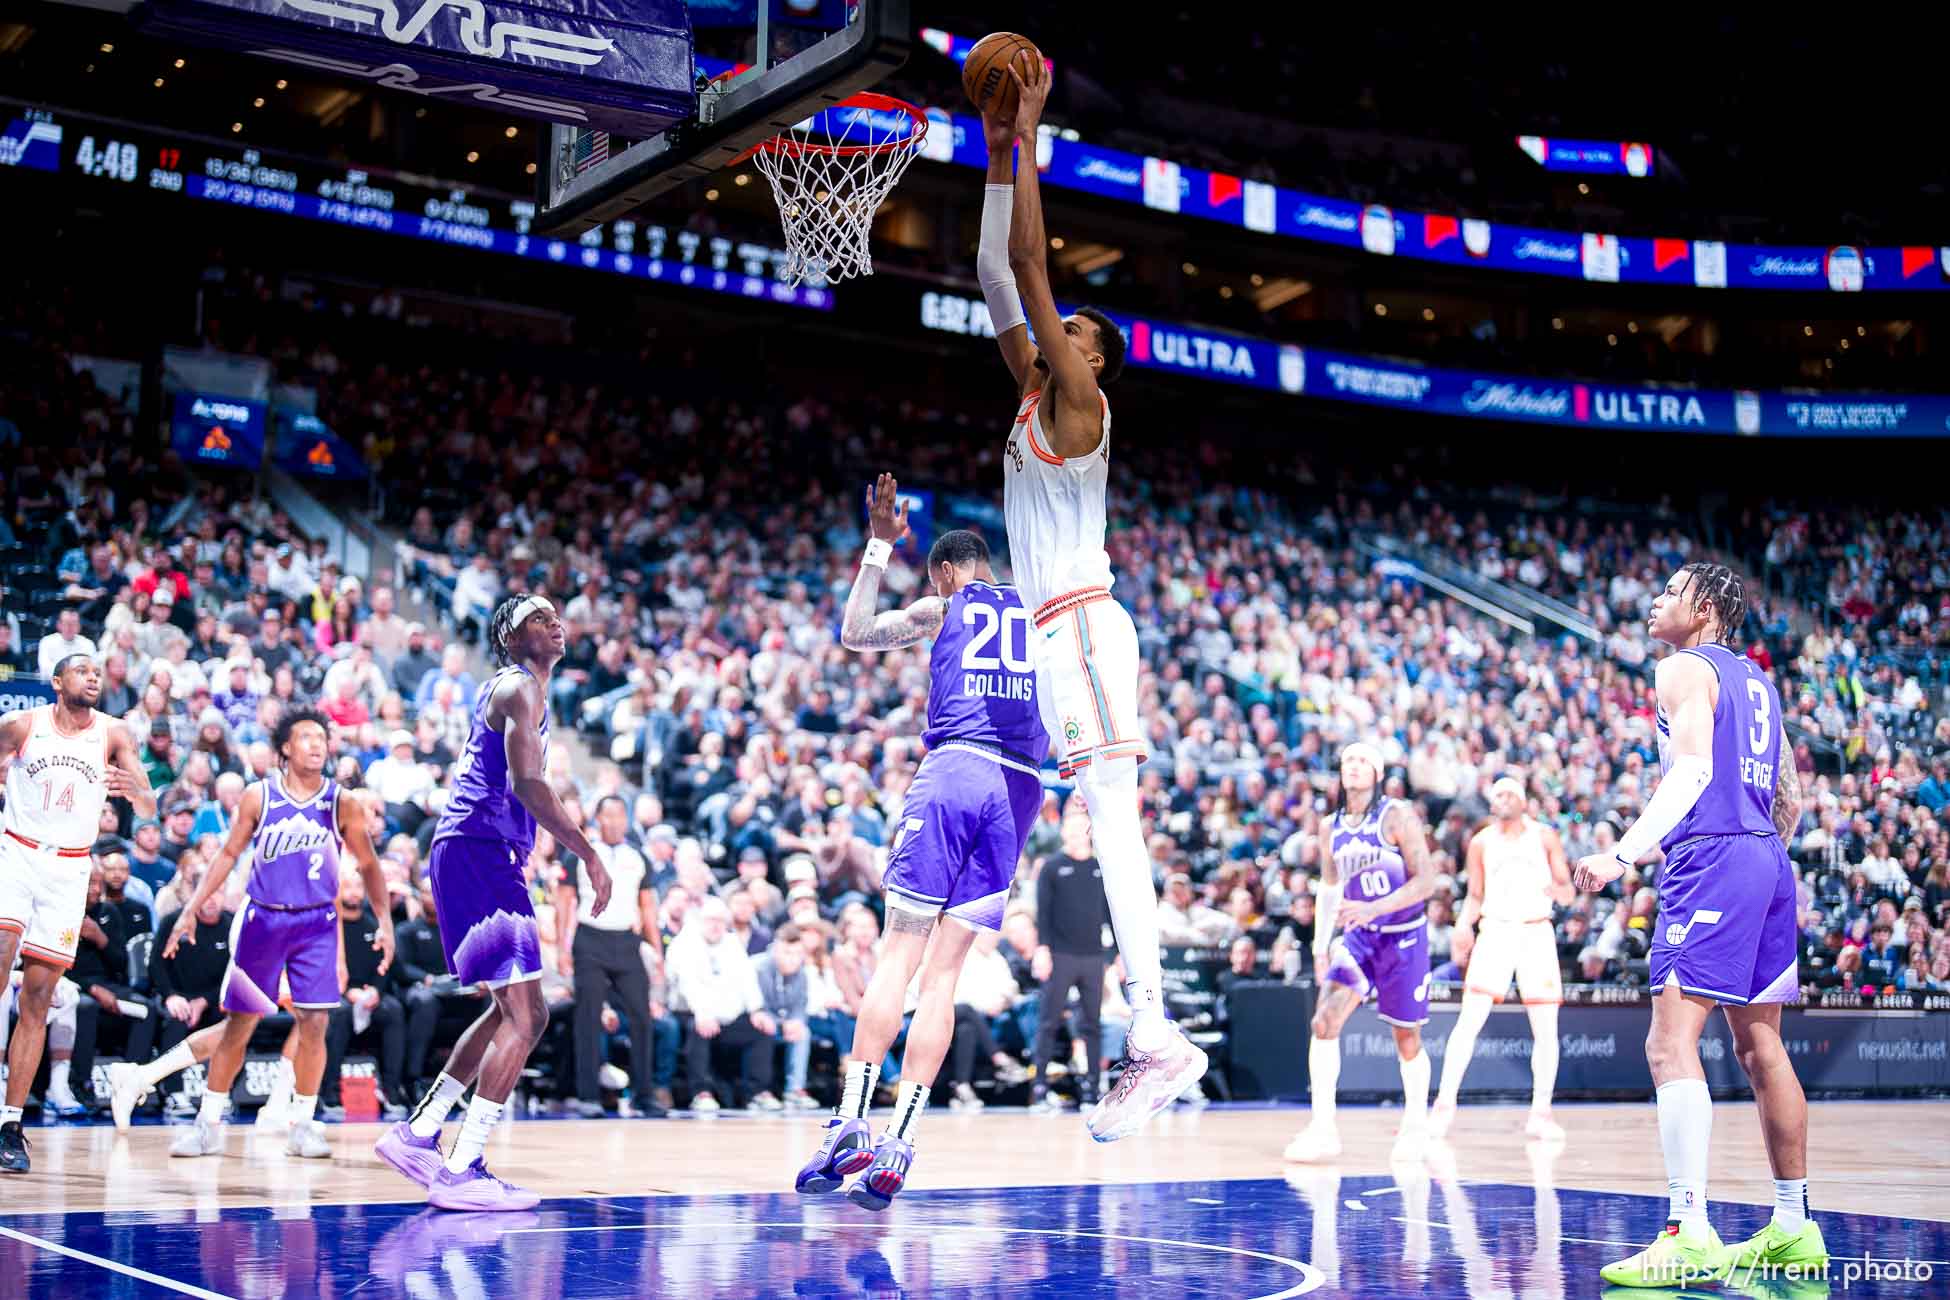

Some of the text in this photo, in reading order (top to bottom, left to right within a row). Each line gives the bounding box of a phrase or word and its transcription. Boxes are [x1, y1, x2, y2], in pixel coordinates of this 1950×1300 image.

[1153, 330, 1256, 378] ULTRA
[1595, 391, 1705, 426] ULTRA
[961, 602, 1035, 673] 20
[964, 673, 1032, 701] COLLINS
[1746, 678, 1770, 756] 3
[27, 755, 98, 783] SAN ANTONIO
[43, 779, 75, 813] 14
[308, 853, 324, 880] 2
[1360, 870, 1392, 897] 00
[1562, 1033, 1616, 1058] Solved
